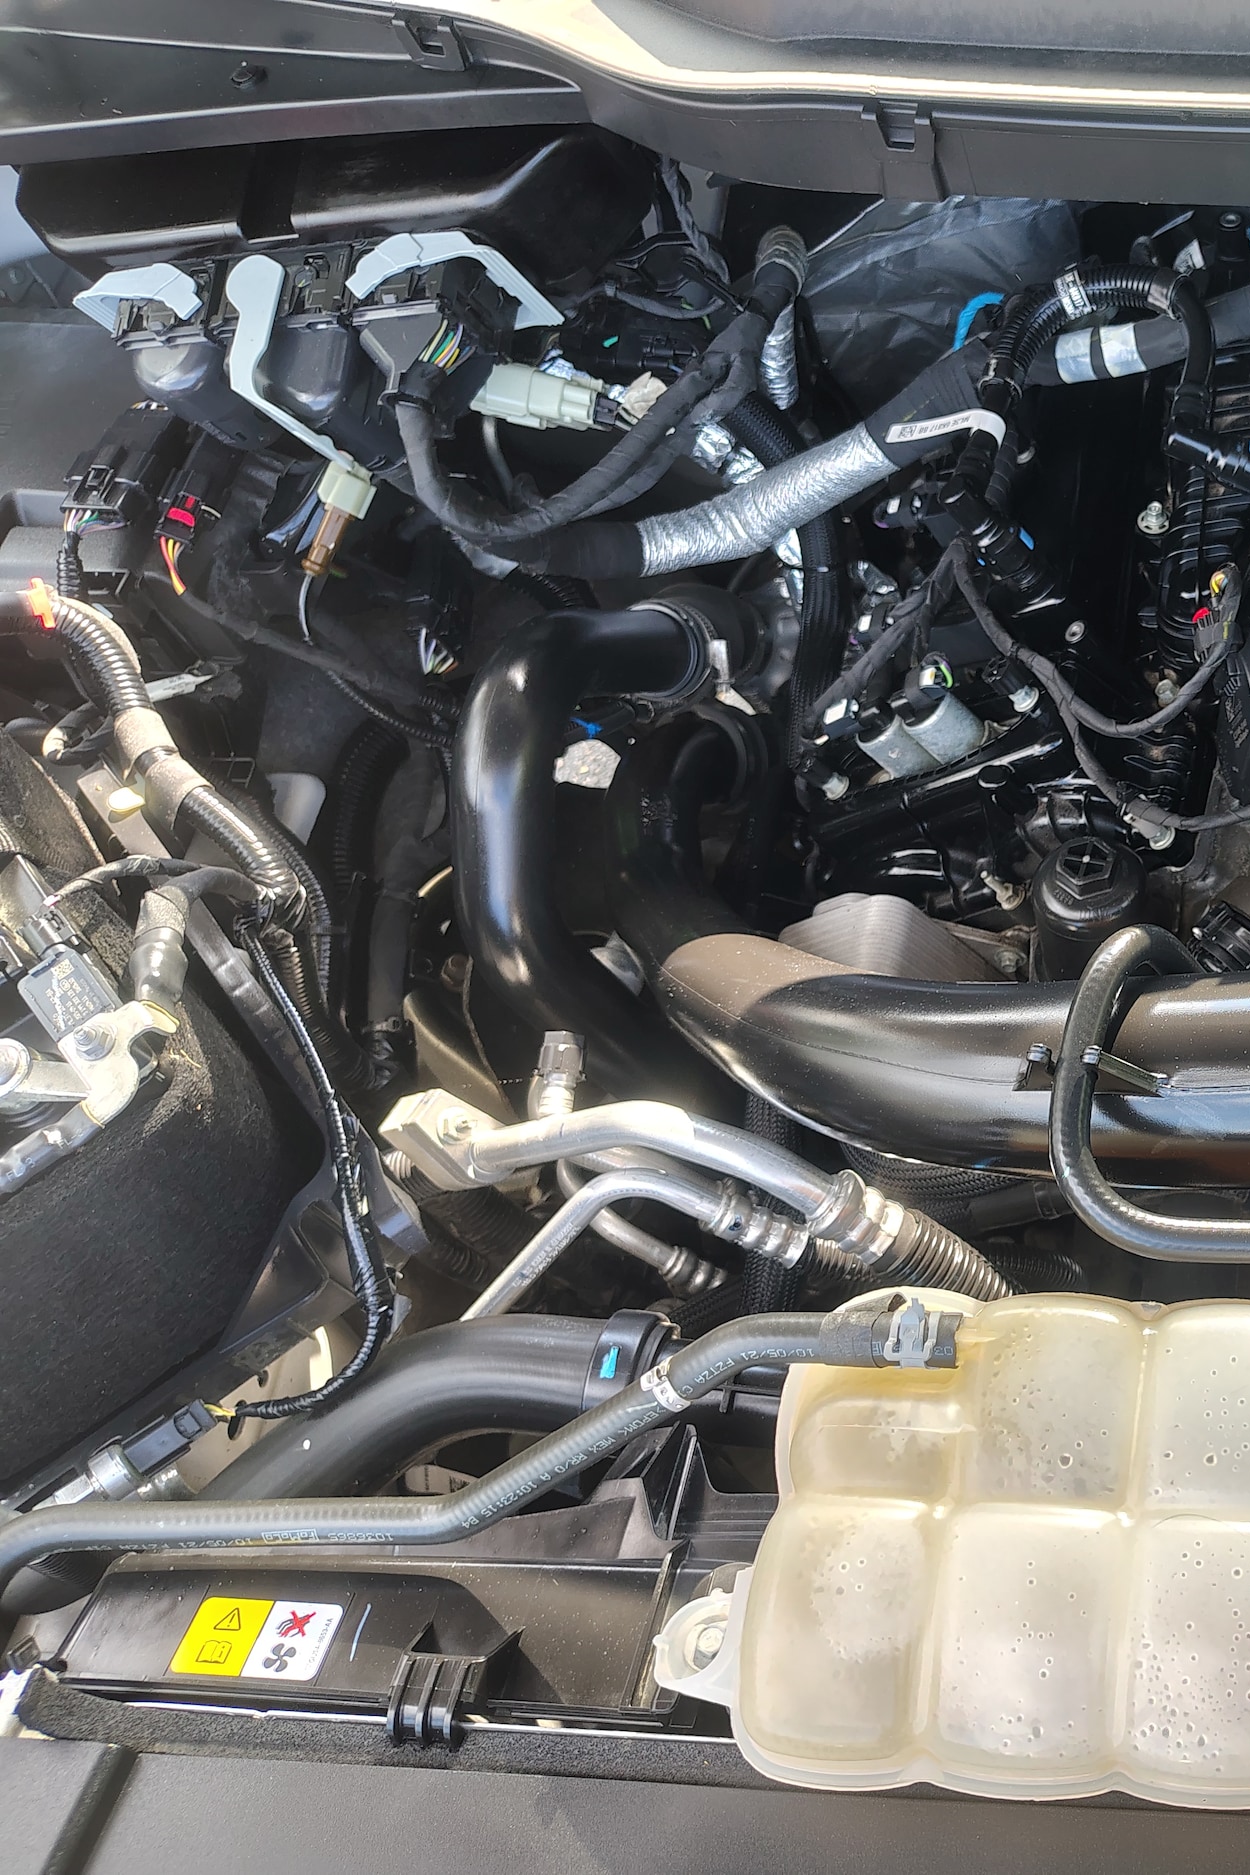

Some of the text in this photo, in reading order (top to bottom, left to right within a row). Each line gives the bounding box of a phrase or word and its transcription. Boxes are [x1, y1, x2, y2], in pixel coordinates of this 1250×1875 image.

[741, 1347, 814, 1360] 10/05/21
[261, 1528, 316, 1543] FoMoCo
[327, 1531, 393, 1541] 1036865
